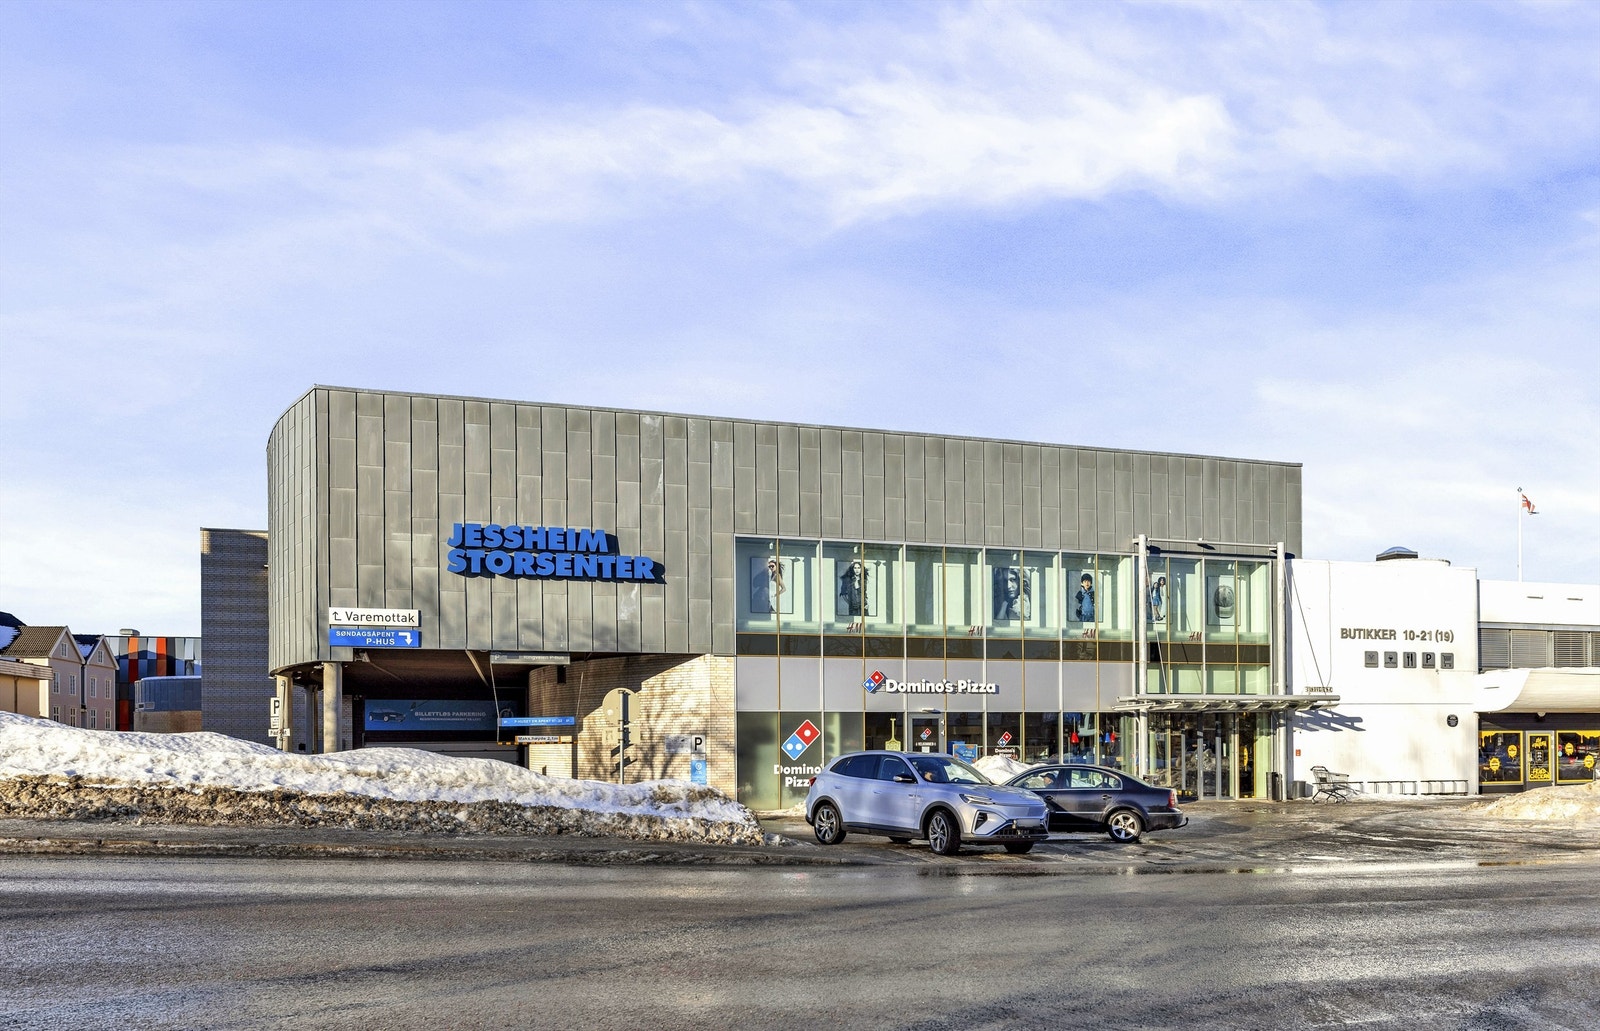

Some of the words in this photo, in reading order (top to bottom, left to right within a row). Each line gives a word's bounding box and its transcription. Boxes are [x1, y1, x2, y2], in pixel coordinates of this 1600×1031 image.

[447, 523, 609, 552] JESSHEIM
[447, 548, 655, 579] STORSENTER
[345, 611, 415, 623] Varemottak
[1340, 628, 1397, 640] BUTIKKER
[1403, 630, 1432, 641] 10-21
[1435, 629, 1454, 643] (19)
[885, 679, 954, 693] Domino's
[957, 679, 996, 693] Pizza
[274, 700, 280, 714] P
[694, 737, 703, 751] P
[773, 763, 824, 774] Domino'
[785, 776, 810, 787] Pizz
